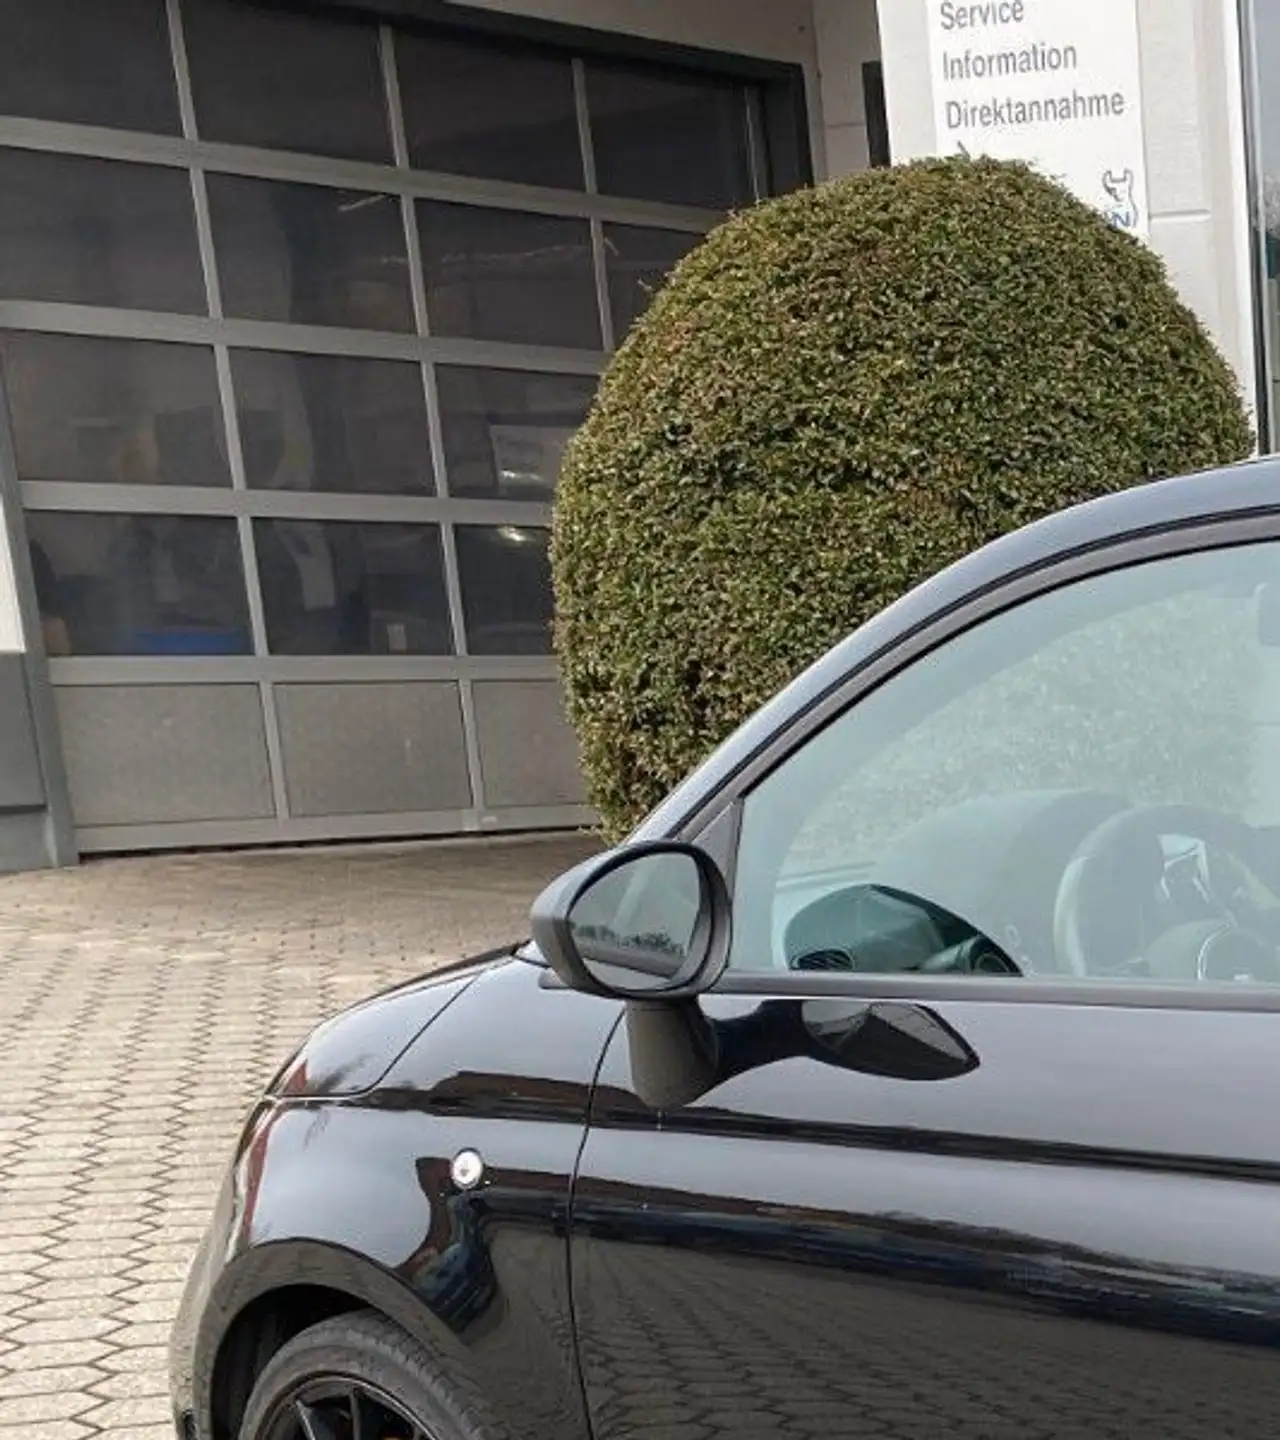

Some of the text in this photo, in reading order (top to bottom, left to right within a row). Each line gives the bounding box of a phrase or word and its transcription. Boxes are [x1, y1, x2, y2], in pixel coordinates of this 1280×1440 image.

[940, 0, 1024, 30] Service
[943, 41, 1077, 81] Information
[946, 88, 1125, 130] Direktannahme
